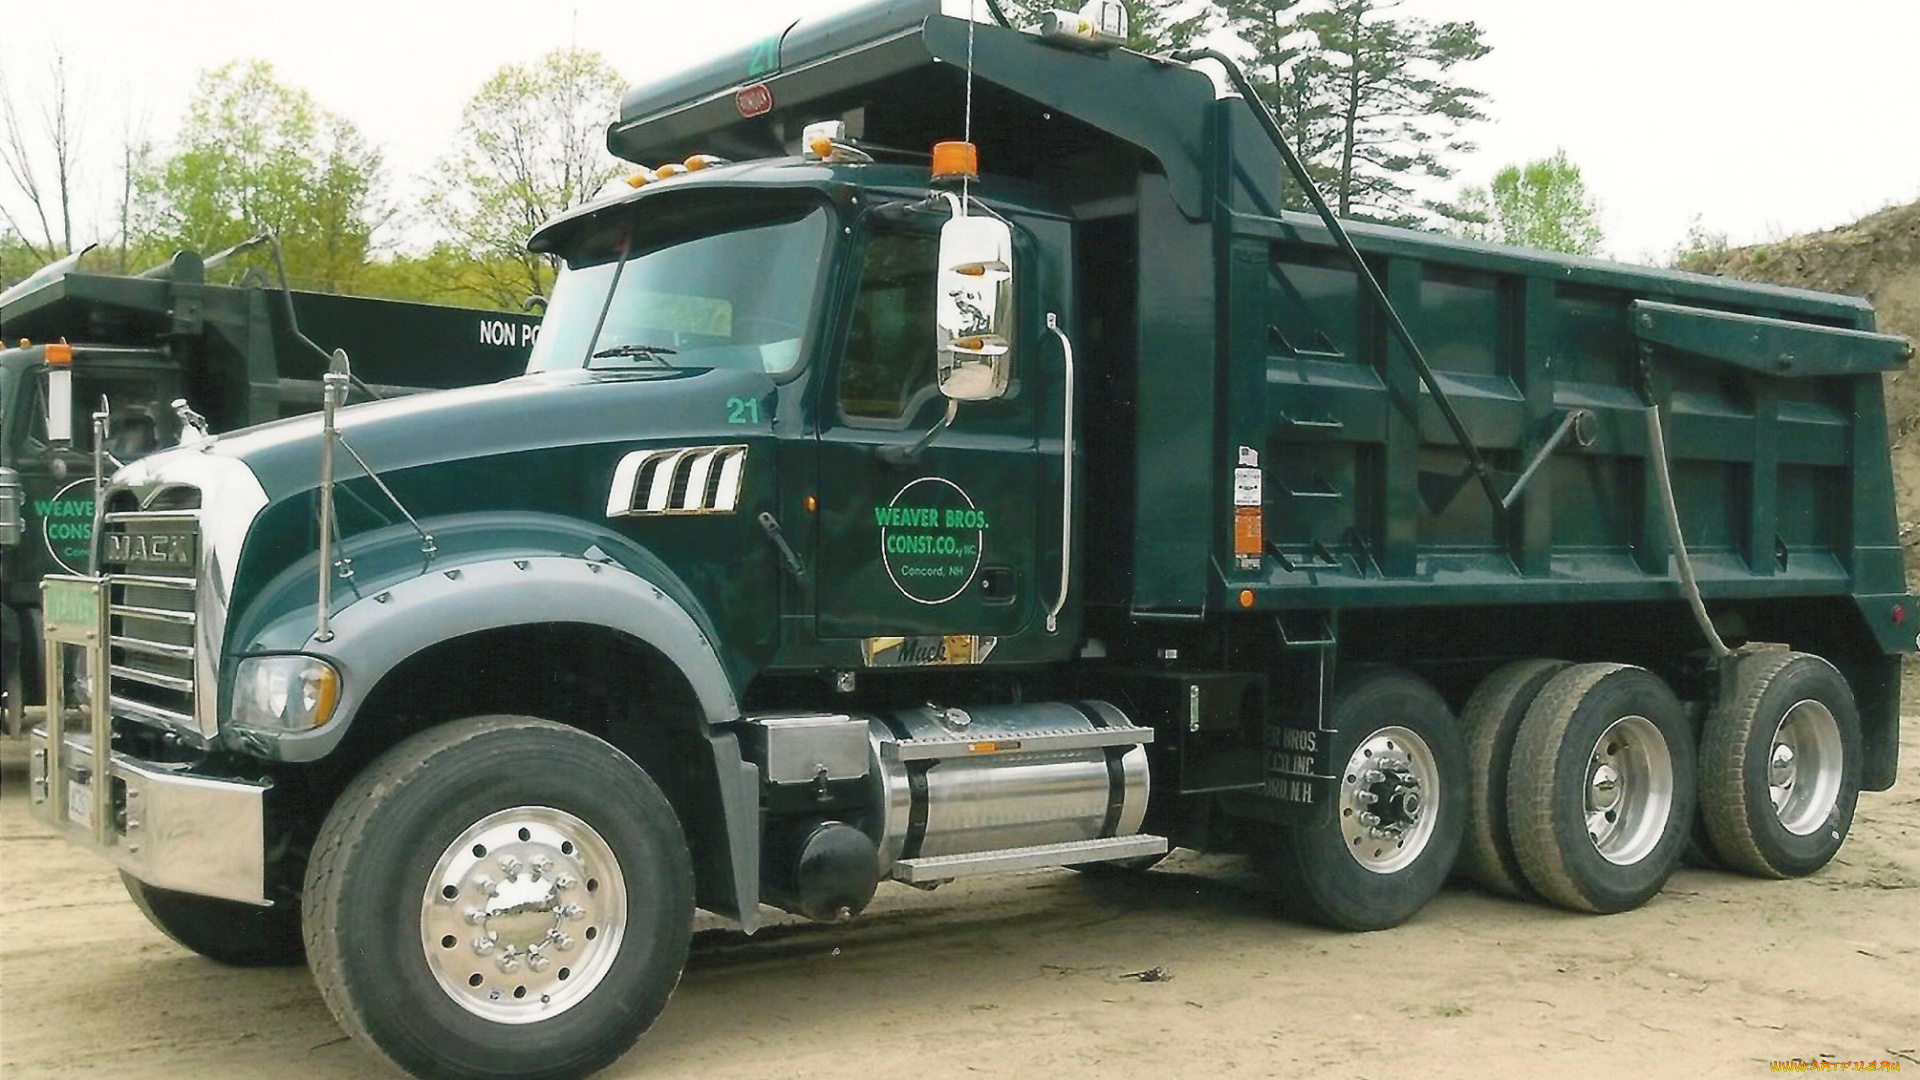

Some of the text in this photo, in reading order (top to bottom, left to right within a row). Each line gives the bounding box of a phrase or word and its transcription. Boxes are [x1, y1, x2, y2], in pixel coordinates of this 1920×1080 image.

[748, 36, 776, 76] 21
[480, 320, 516, 346] NON
[727, 397, 758, 424] 21
[875, 507, 989, 528] WEAVER BROS.
[108, 535, 187, 563] MACK
[901, 565, 964, 577] Concord, NH
[1283, 728, 1318, 752] BROS.
